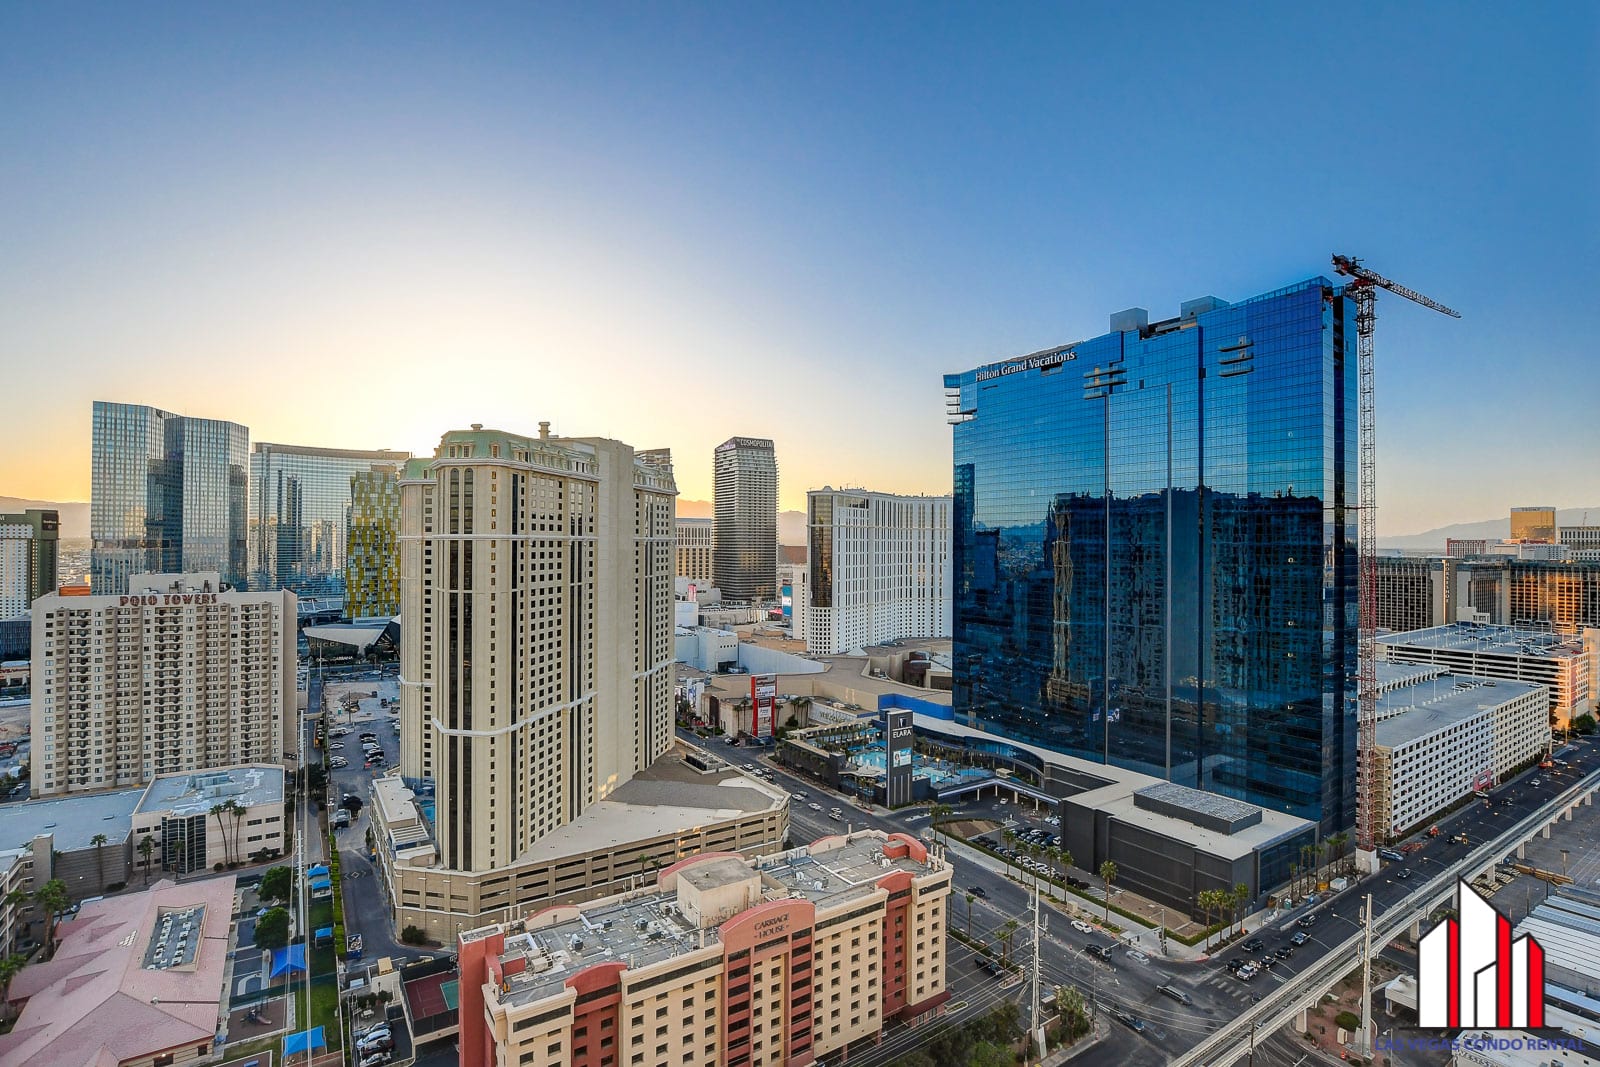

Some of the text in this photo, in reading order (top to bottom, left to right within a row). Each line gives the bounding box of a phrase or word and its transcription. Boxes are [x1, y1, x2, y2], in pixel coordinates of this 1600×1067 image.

[976, 351, 1076, 382] Hilton Grand Vacations
[119, 593, 218, 607] POLO TOWERS
[892, 729, 912, 739] ELARA
[754, 912, 789, 931] CARRIAGE
[759, 925, 785, 939] HOUSE
